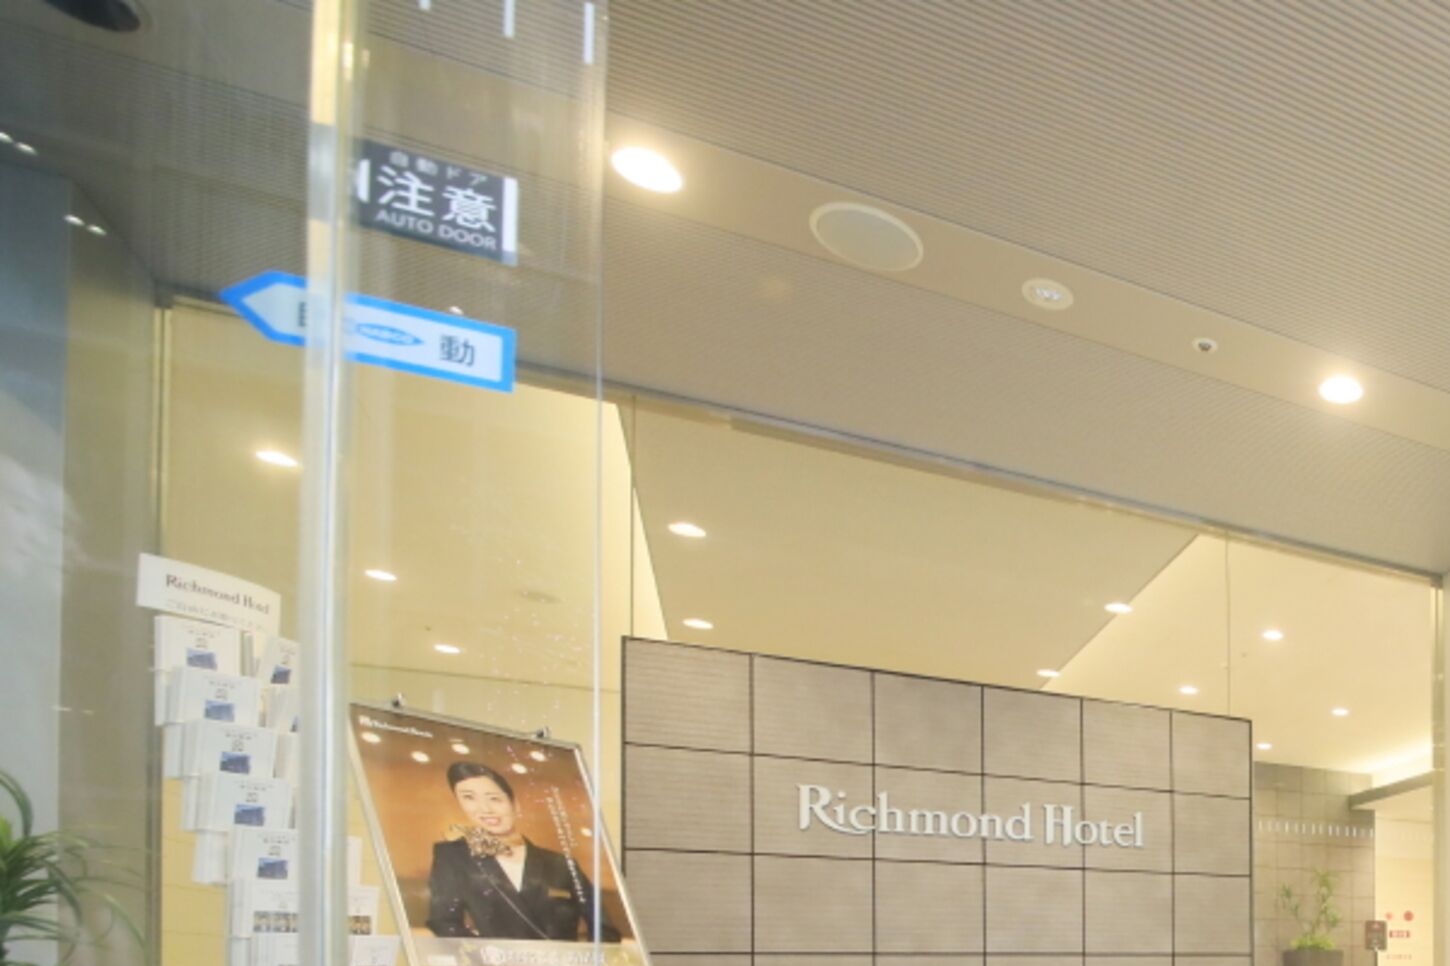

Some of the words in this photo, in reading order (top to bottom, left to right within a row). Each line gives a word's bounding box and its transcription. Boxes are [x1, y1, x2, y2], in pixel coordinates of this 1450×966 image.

[375, 210, 434, 234] AUTO
[438, 224, 497, 250] DOOR
[377, 165, 496, 232] 注意
[796, 784, 1034, 841] Richmond
[1043, 803, 1144, 848] Hotel
